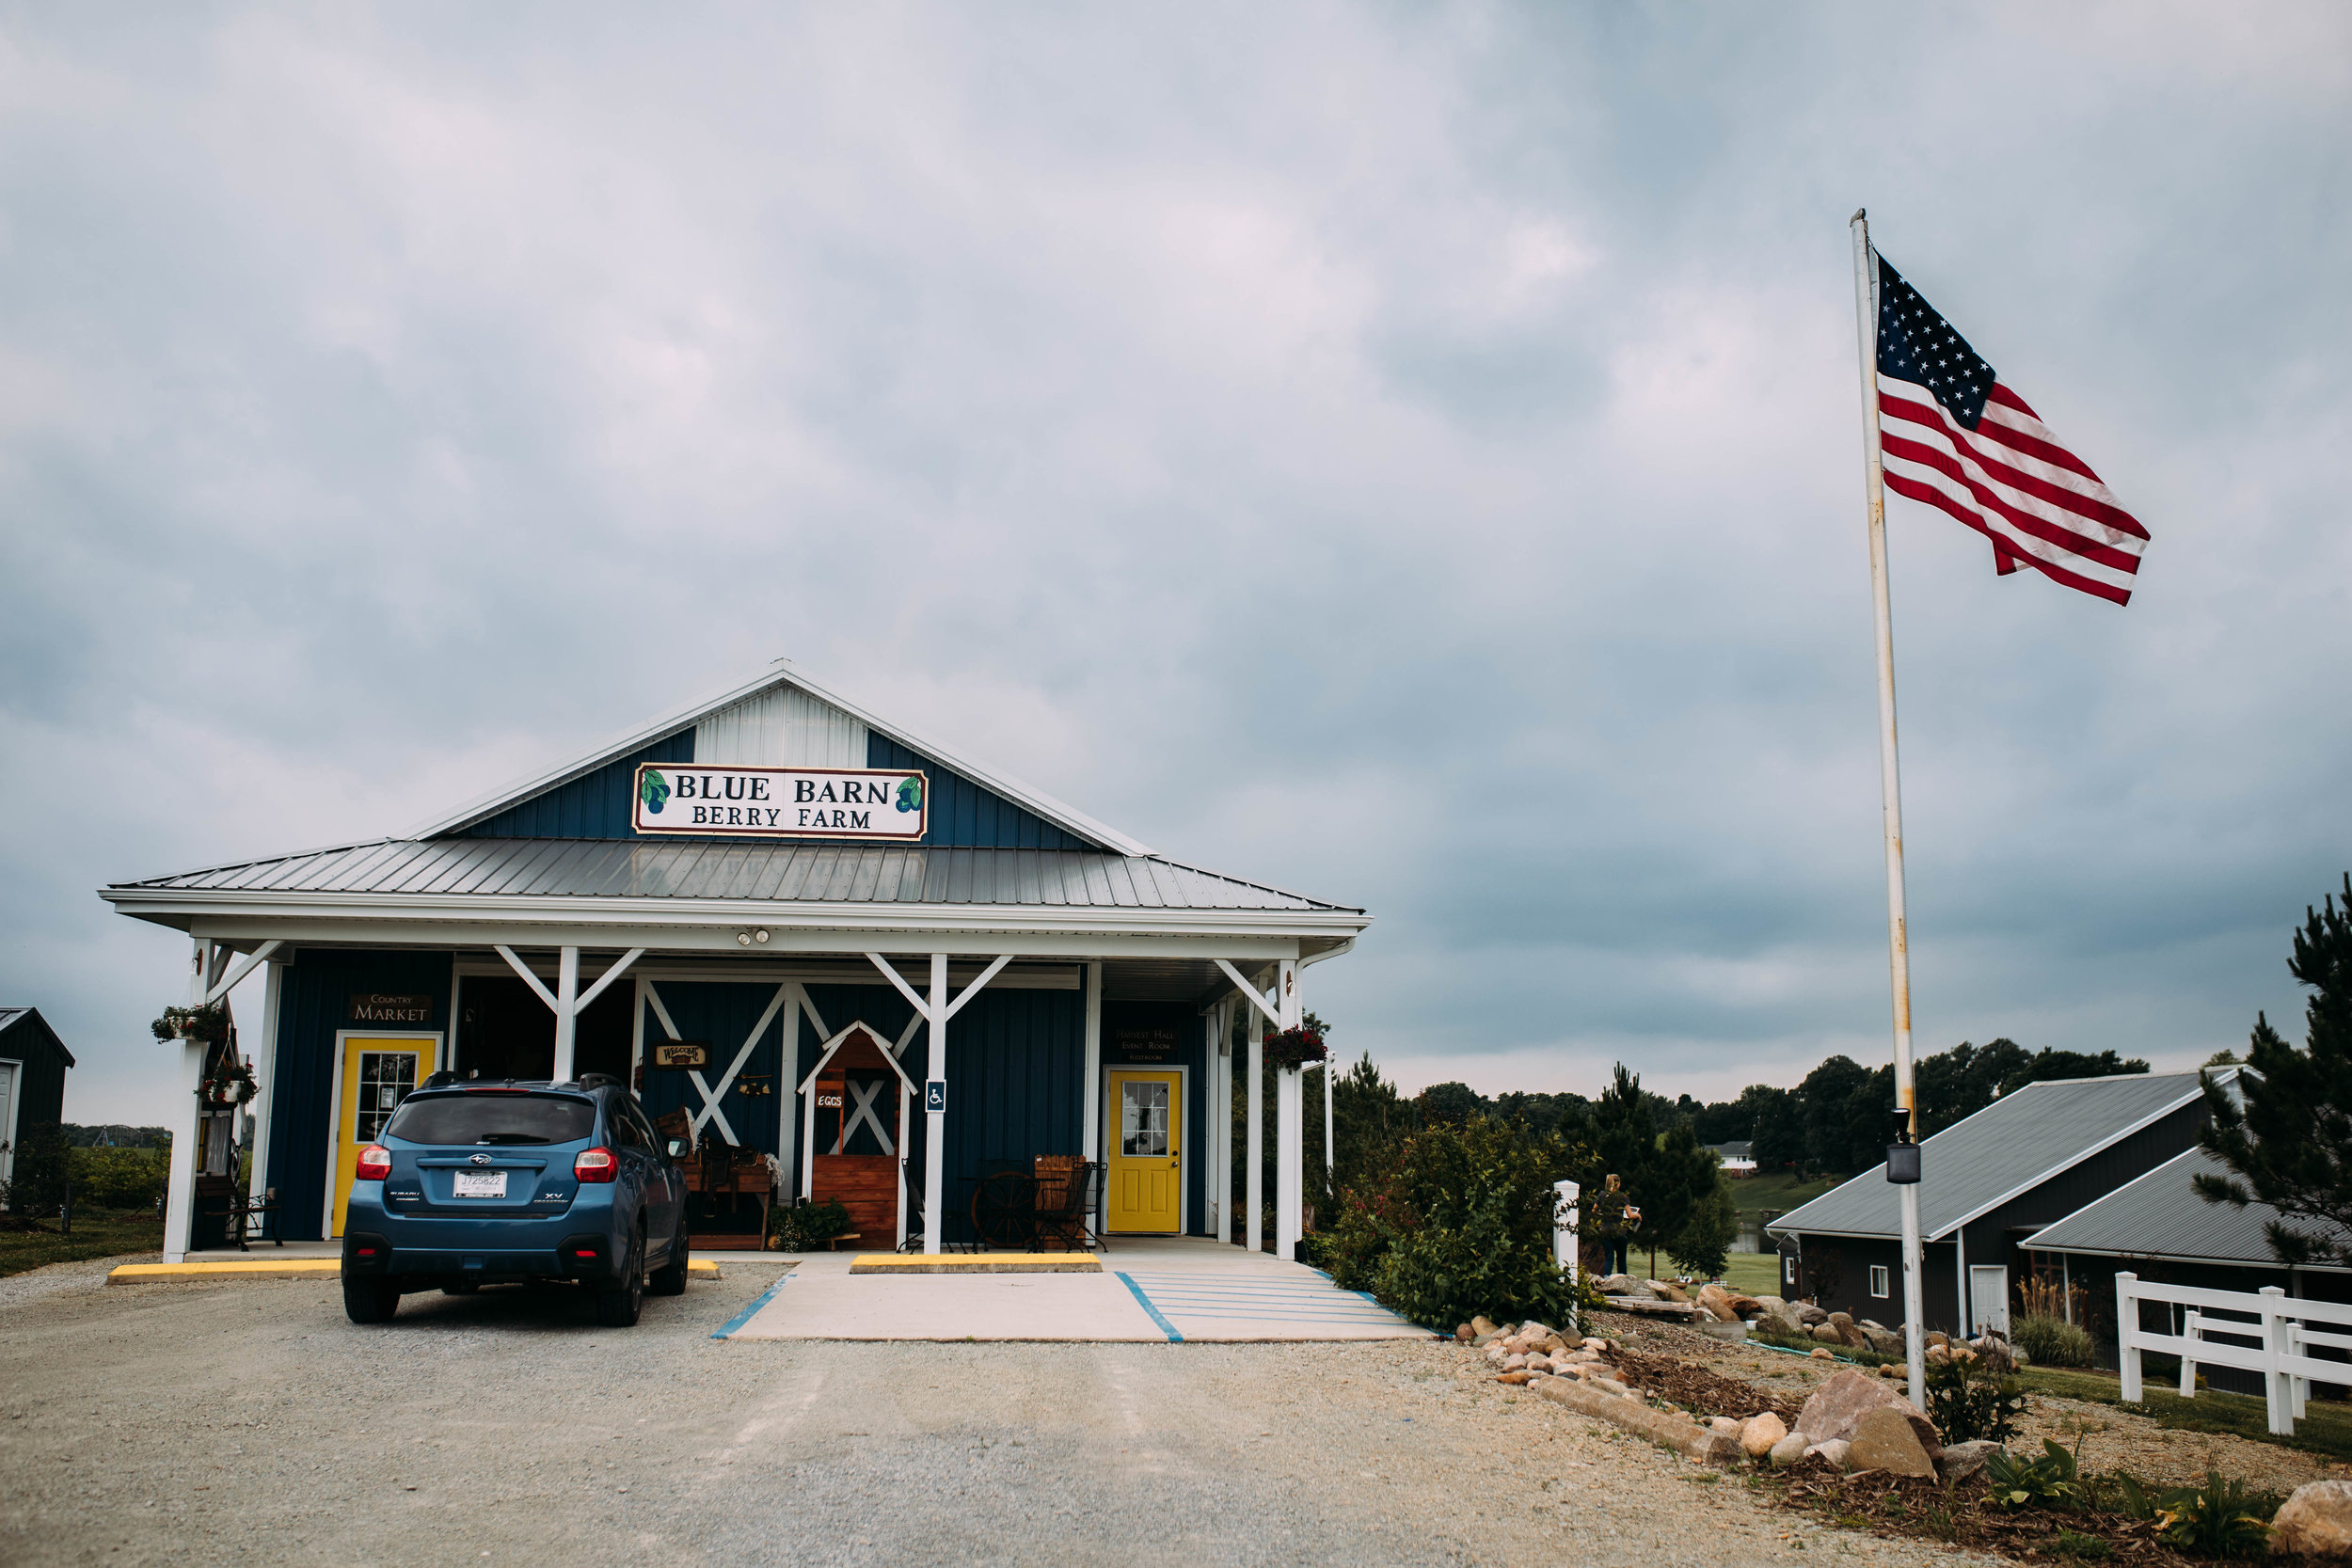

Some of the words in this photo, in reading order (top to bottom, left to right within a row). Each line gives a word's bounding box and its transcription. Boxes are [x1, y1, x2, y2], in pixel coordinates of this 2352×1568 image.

[675, 774, 771, 800] BLUE
[794, 779, 890, 804] BARN
[691, 805, 781, 827] BERRY
[798, 808, 871, 830] FARM
[355, 1004, 428, 1022] MARKET
[663, 1046, 700, 1062] WELCOME
